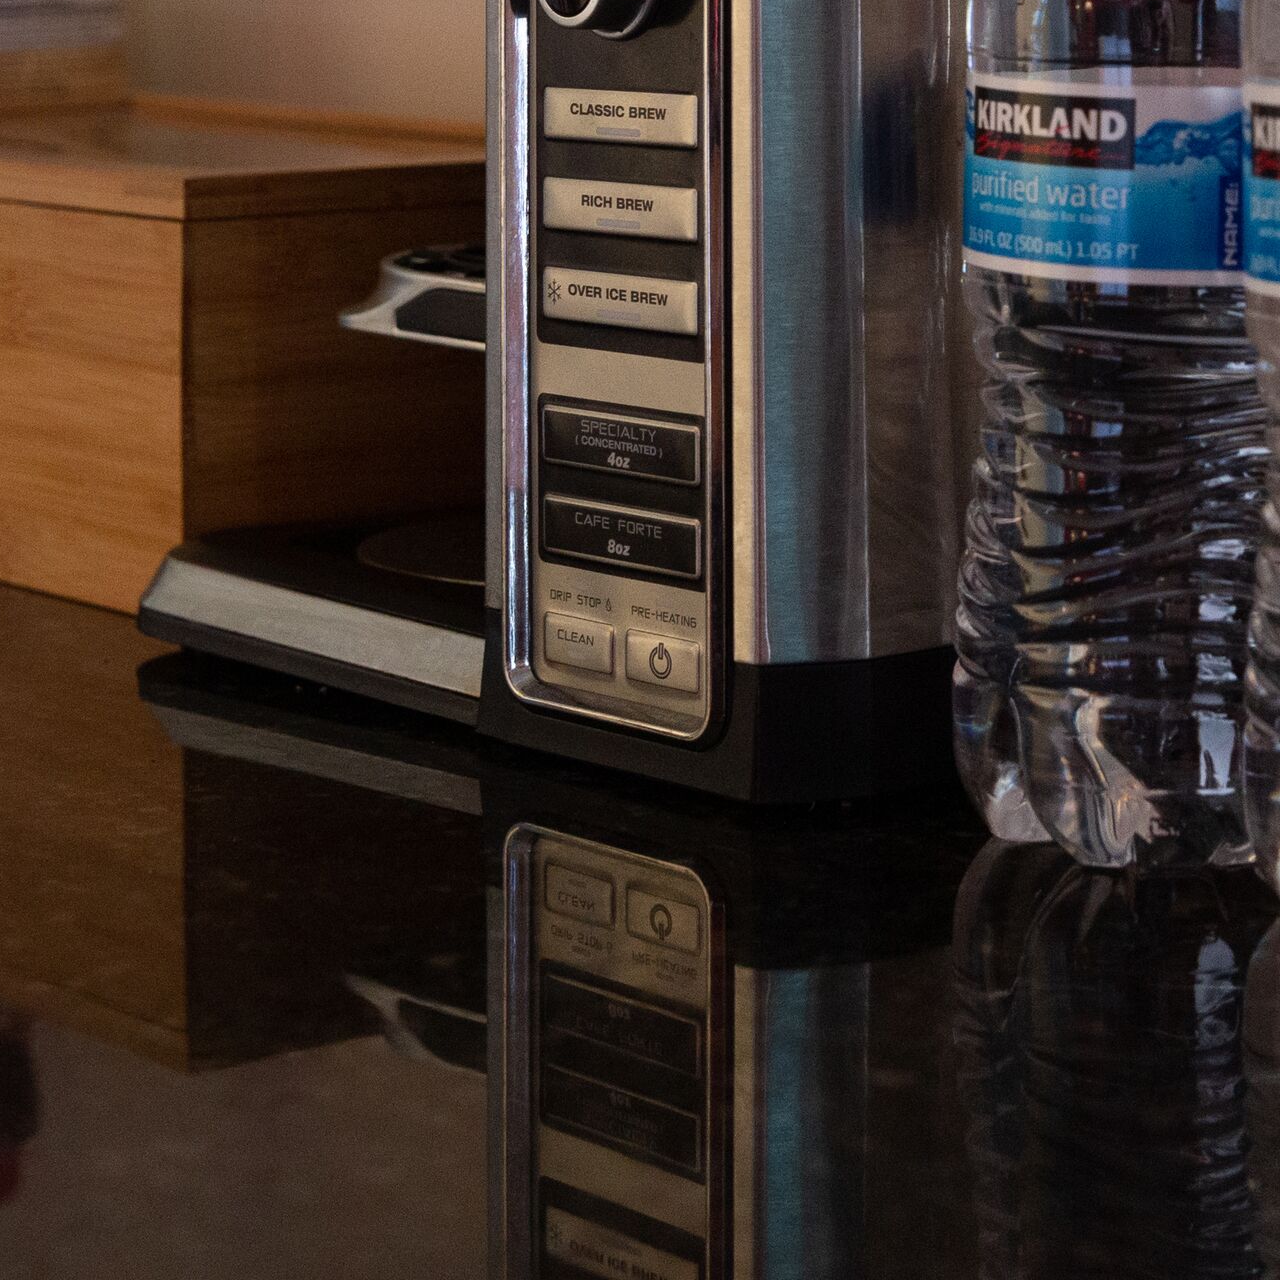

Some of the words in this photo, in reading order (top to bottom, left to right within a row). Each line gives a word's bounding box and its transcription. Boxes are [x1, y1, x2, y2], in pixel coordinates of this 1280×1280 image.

[570, 102, 625, 118] CLASSIC
[628, 106, 667, 120] BREW
[977, 99, 1128, 142] KIRKLAND
[971, 171, 1039, 205] purified
[1045, 182, 1132, 210] water
[581, 194, 612, 208] RICH
[616, 197, 654, 212] BREW
[1014, 233, 1044, 257] (500
[1077, 241, 1112, 260] 1.05
[1116, 243, 1140, 261] PT
[568, 283, 602, 298] OVER
[606, 288, 627, 302] ICE
[630, 290, 668, 306] BREW
[580, 419, 657, 443] SPECIALTY
[607, 452, 630, 468] 4oz
[574, 512, 610, 530] CAFE
[618, 520, 662, 539] FORTE
[607, 539, 631, 557] 8oz
[549, 588, 572, 602] DRIP
[577, 594, 601, 608] STOP
[631, 605, 697, 629] PRE-HEATING
[557, 629, 595, 647] CLEAN
